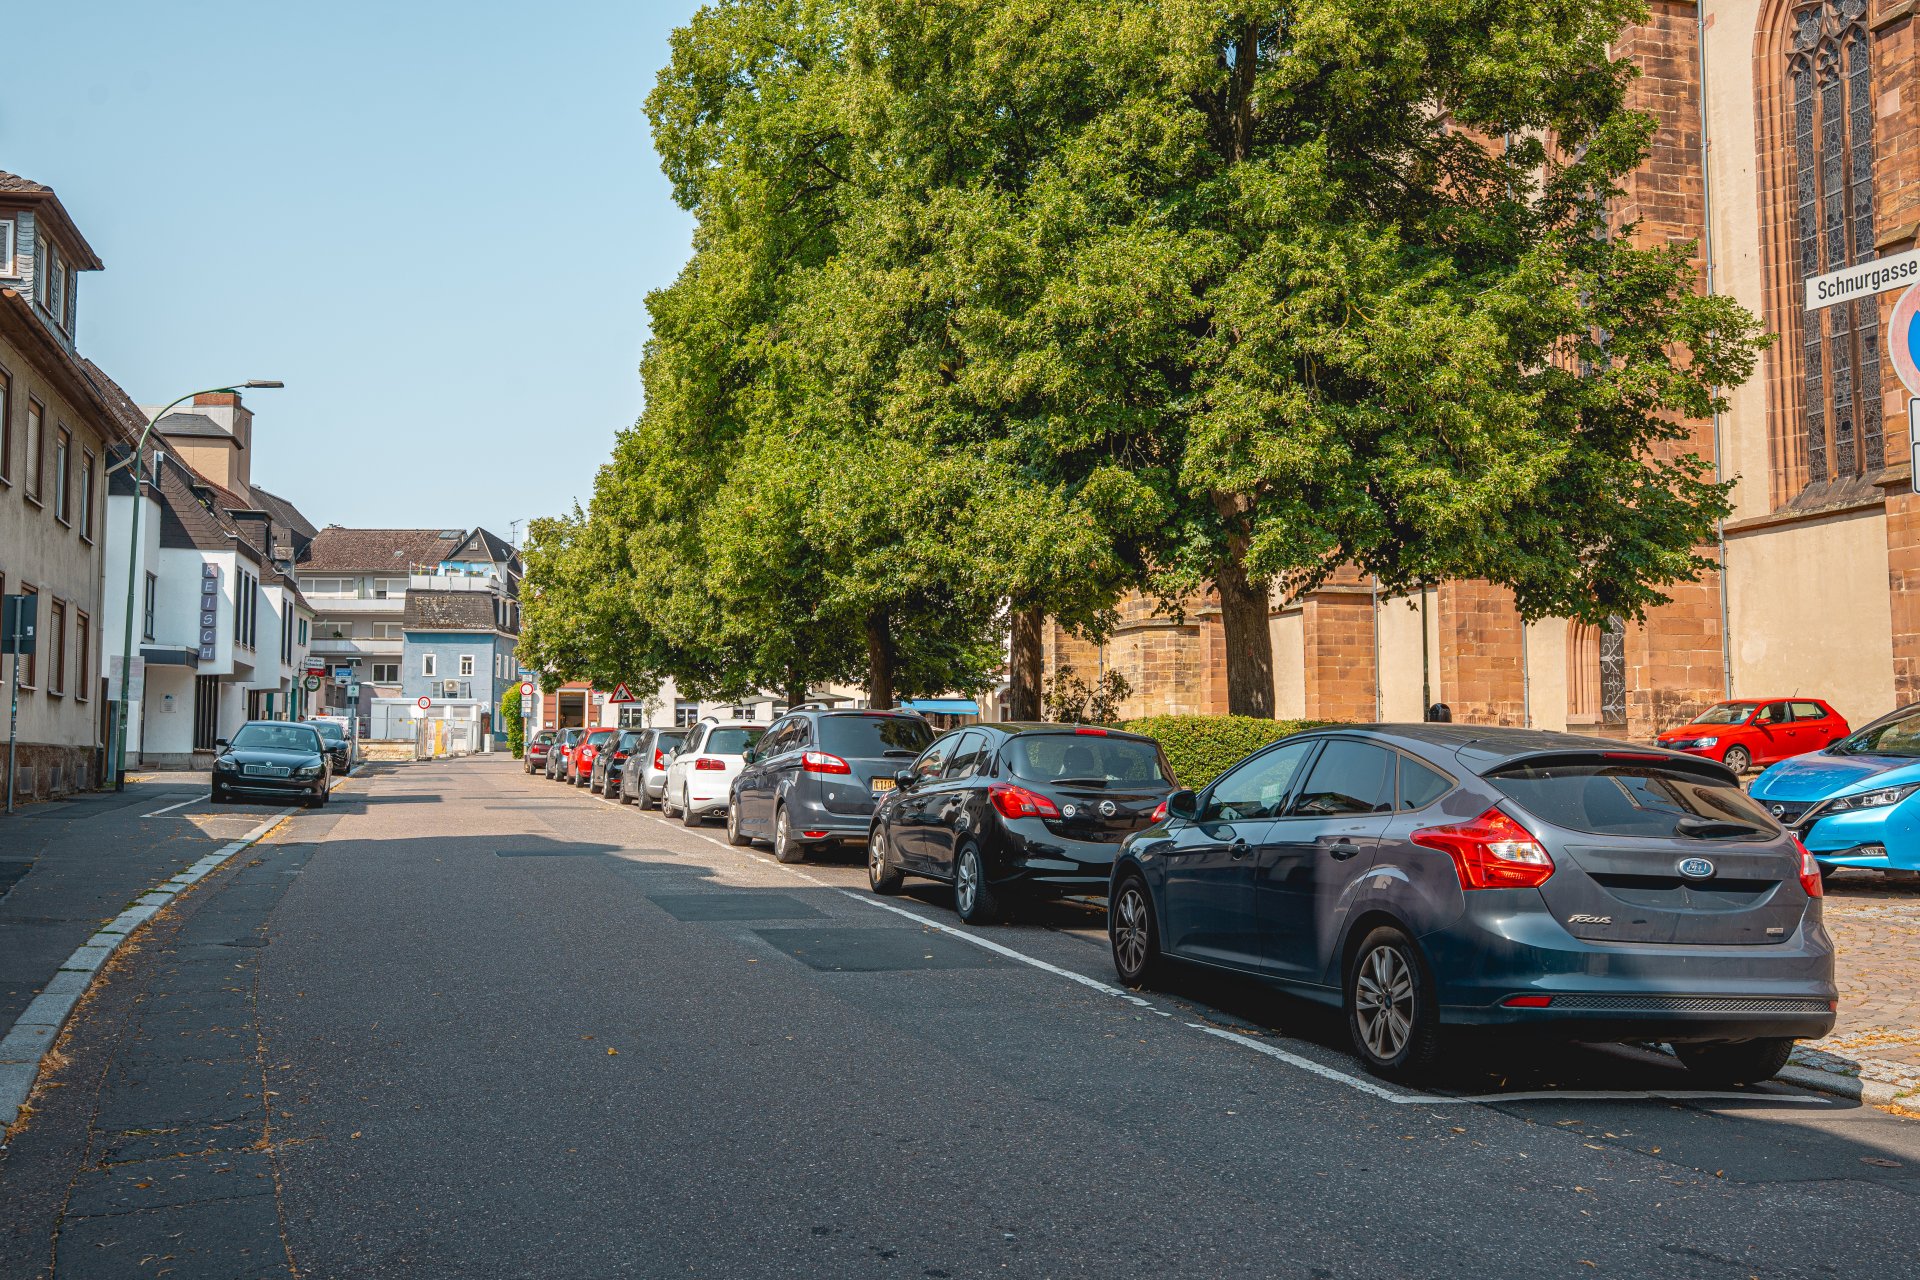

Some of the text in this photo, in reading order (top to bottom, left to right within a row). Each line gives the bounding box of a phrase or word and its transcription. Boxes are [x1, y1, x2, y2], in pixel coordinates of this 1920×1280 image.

[1817, 260, 1918, 300] Schnurgasse
[202, 564, 216, 658] REISCH
[1568, 914, 1612, 924] Focus
